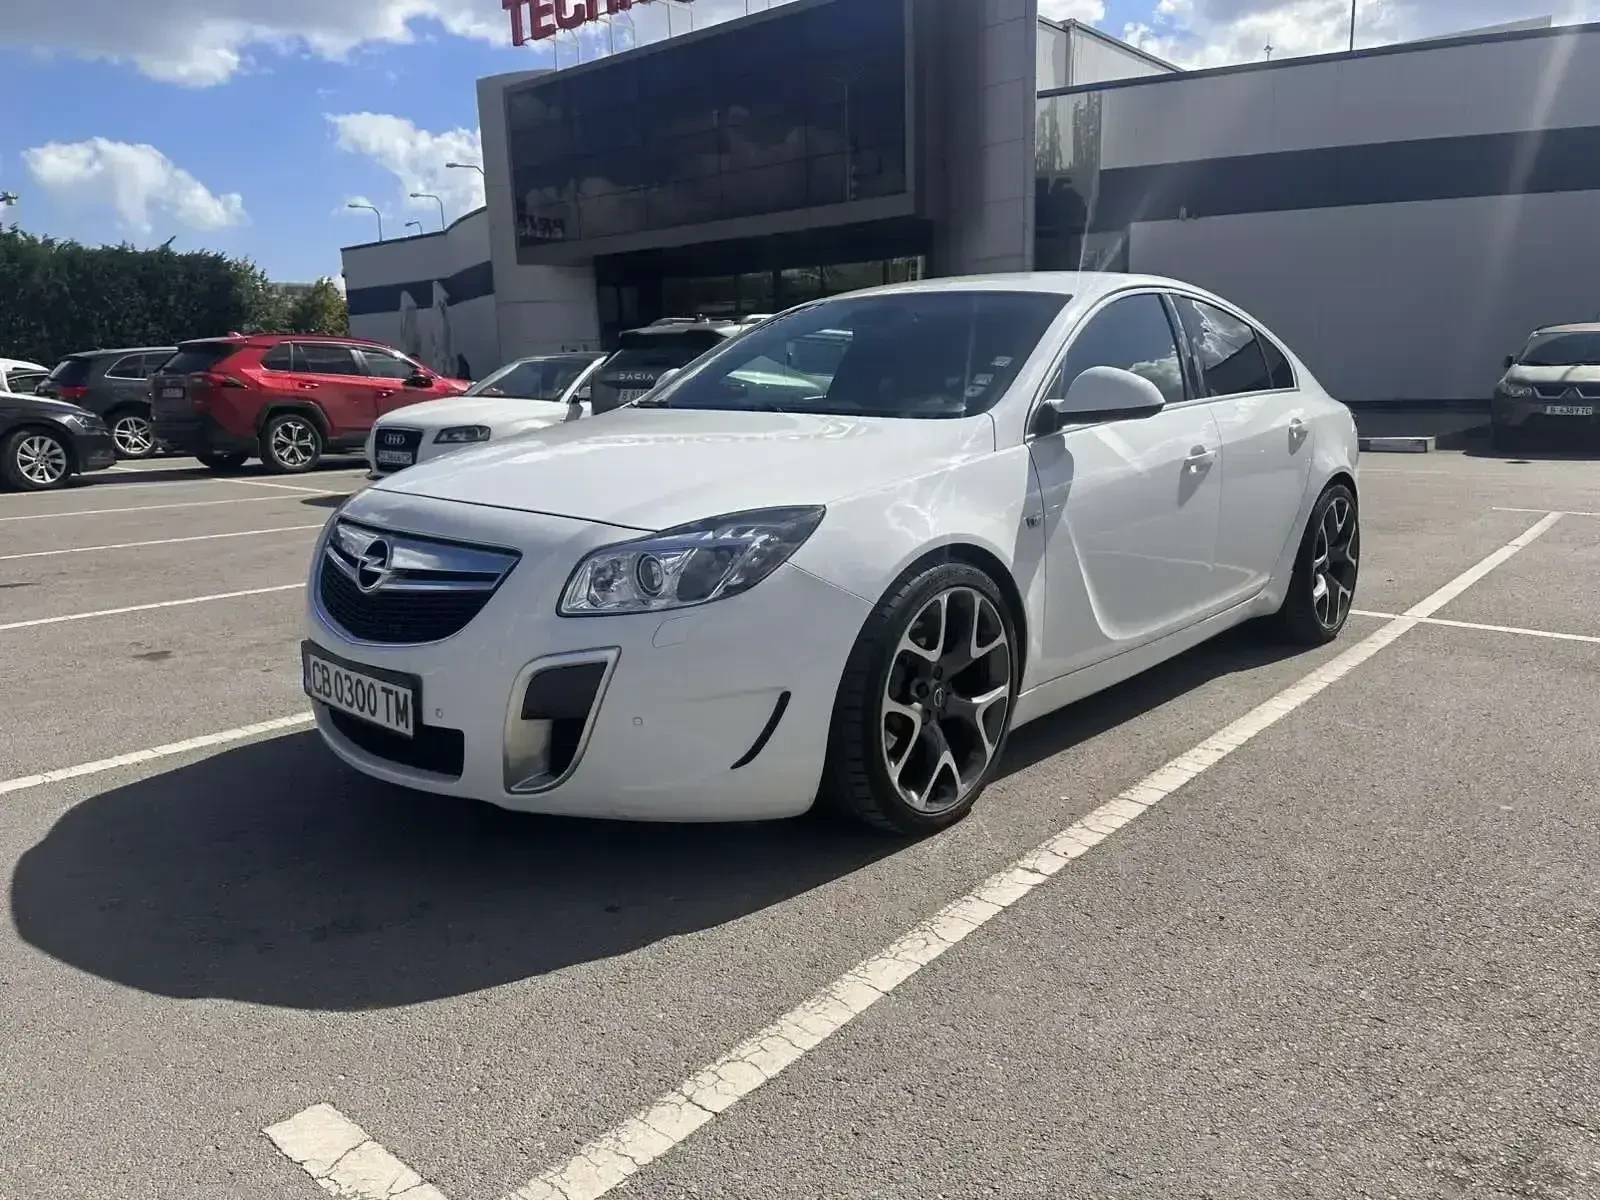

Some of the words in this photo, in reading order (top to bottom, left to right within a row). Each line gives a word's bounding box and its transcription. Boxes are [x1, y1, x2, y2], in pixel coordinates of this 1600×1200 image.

[618, 373, 654, 381] DACIA
[312, 661, 332, 698] CB
[334, 670, 377, 717] 0300
[381, 686, 409, 729] TM
